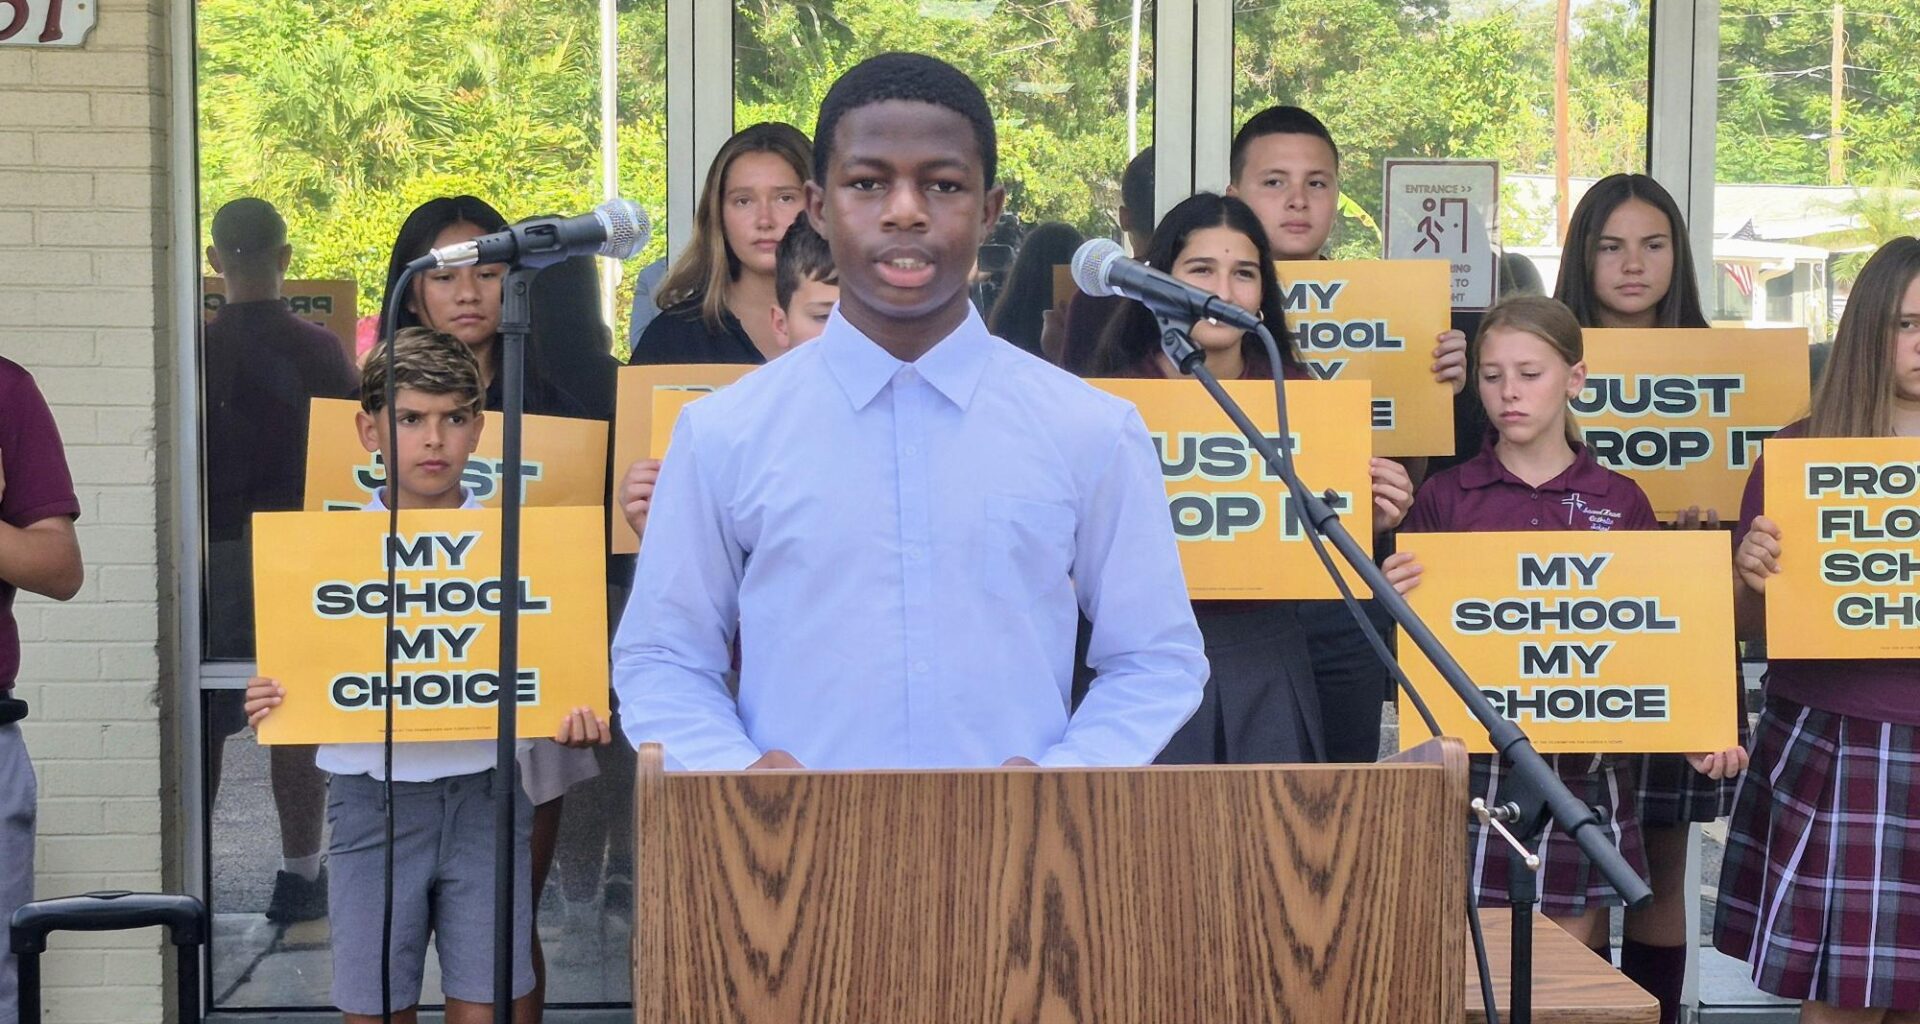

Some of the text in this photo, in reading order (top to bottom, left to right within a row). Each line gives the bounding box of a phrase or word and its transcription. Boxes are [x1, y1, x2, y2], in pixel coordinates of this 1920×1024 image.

[1405, 184, 1458, 194] ENTRANCE
[1292, 321, 1402, 349] HOOL
[1570, 378, 1741, 414] JUST
[1152, 436, 1296, 477] UST
[1586, 430, 1710, 466] ROP
[1809, 465, 1920, 495] PRO
[1168, 495, 1261, 537] OP
[386, 535, 475, 567] MY
[1522, 557, 1606, 586] MY
[317, 581, 548, 615] SCHOOL
[1837, 596, 1920, 626] CH
[1455, 600, 1676, 631] SCHOOL
[388, 627, 476, 660] MY
[1523, 645, 1608, 674] MY
[332, 671, 537, 706] CHOICE
